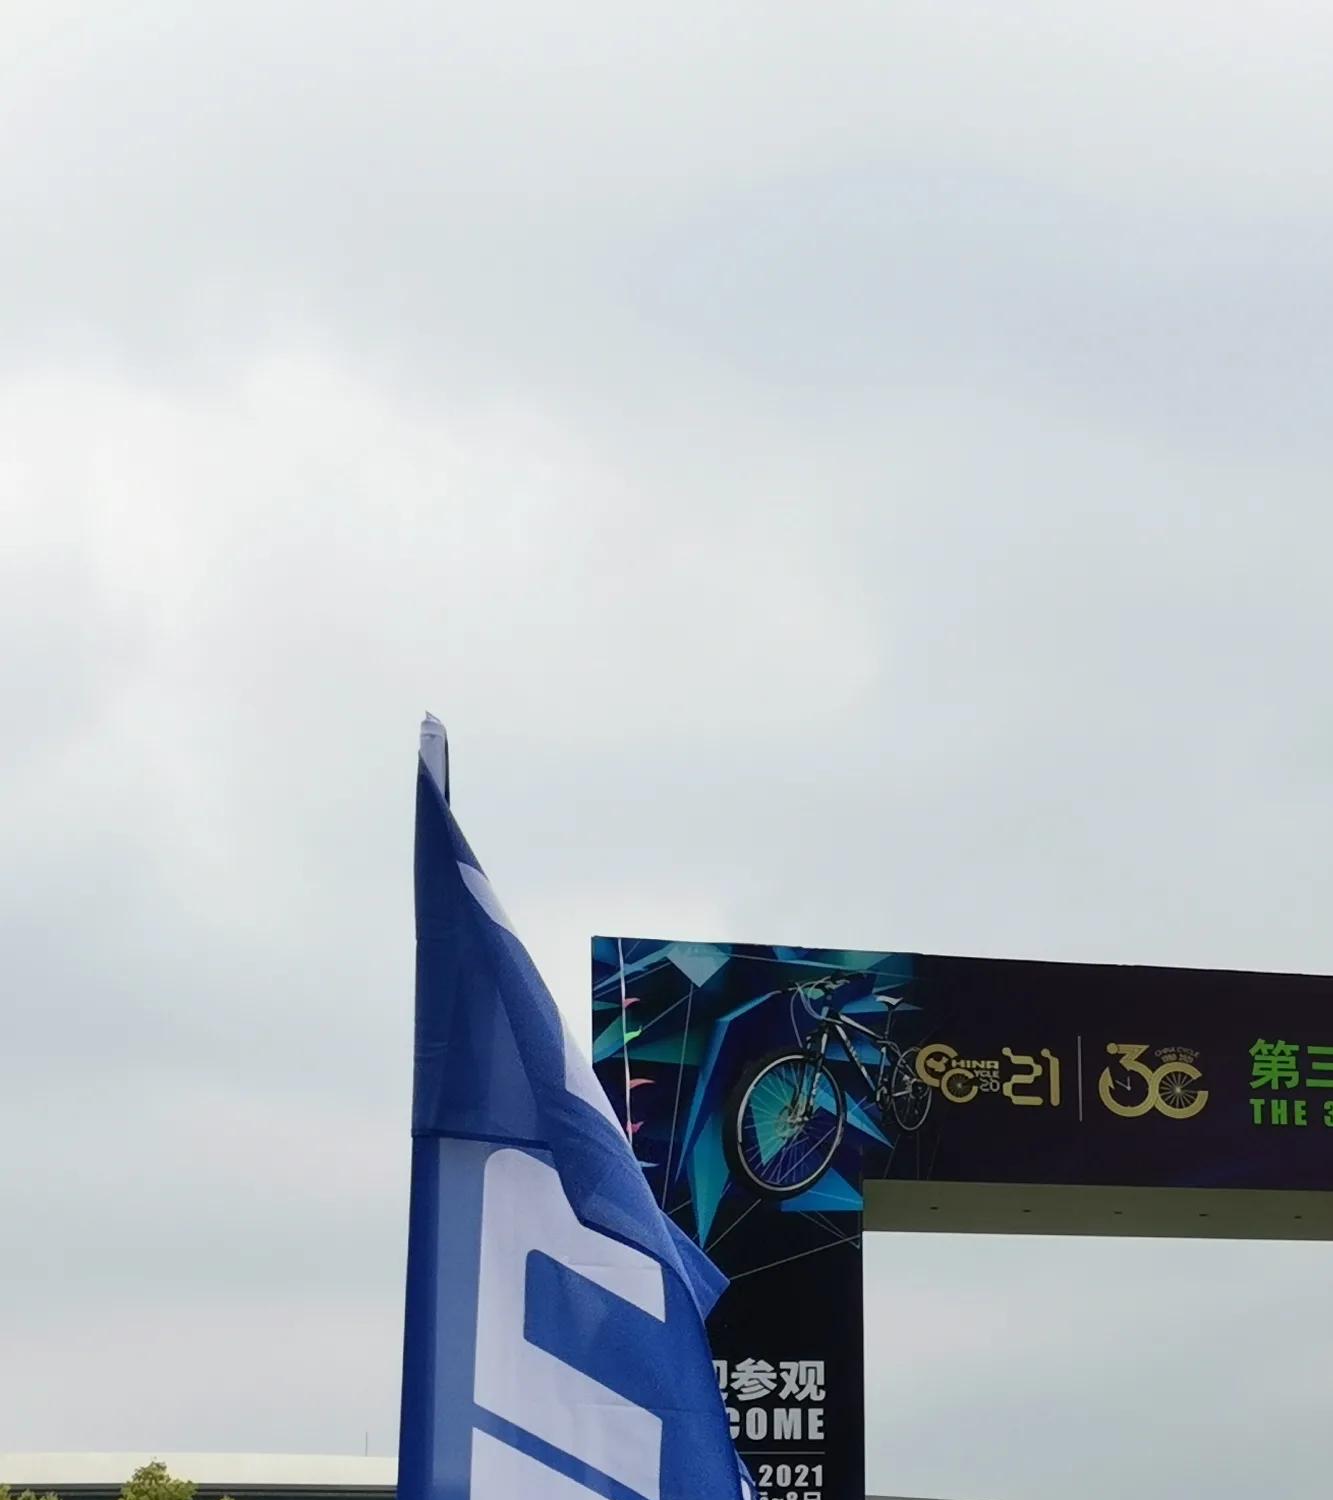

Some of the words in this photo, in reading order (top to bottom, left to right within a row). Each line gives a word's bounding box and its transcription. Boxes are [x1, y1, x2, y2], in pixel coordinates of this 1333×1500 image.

[1250, 1097, 1308, 1126] THE
[712, 1357, 826, 1402] 参观
[725, 1406, 825, 1440] COME
[758, 1463, 824, 1488] 2021
